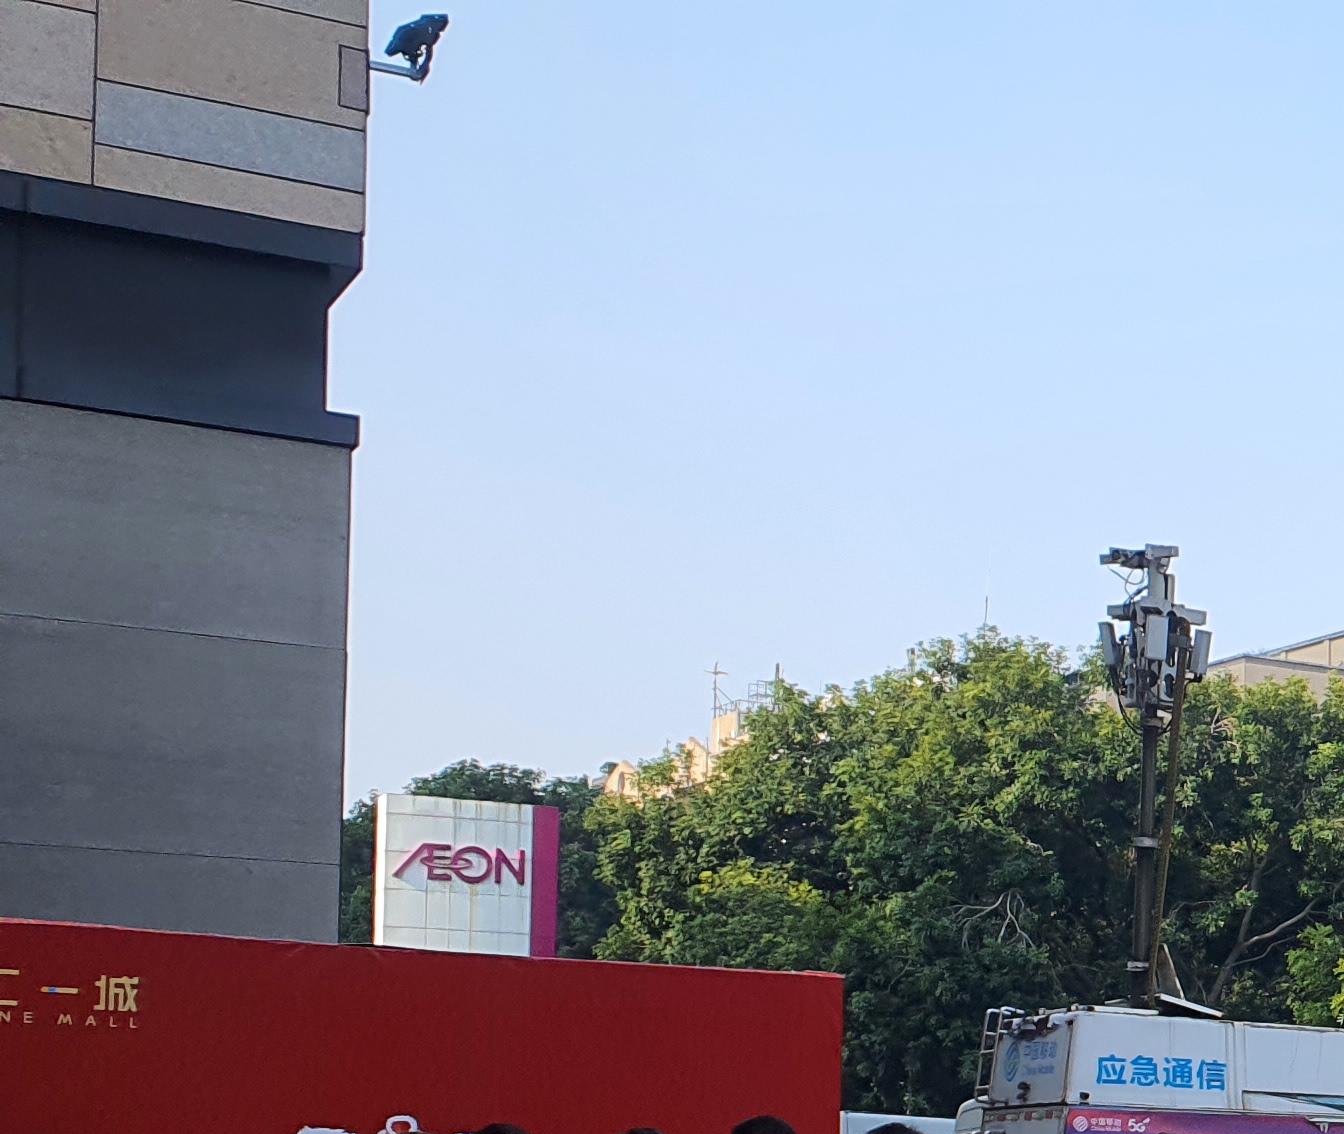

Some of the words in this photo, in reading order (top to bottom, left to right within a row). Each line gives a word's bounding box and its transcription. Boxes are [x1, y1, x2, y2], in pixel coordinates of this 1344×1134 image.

[56, 1013, 138, 1029] MALL
[1096, 1054, 1227, 1091] 应急通信
